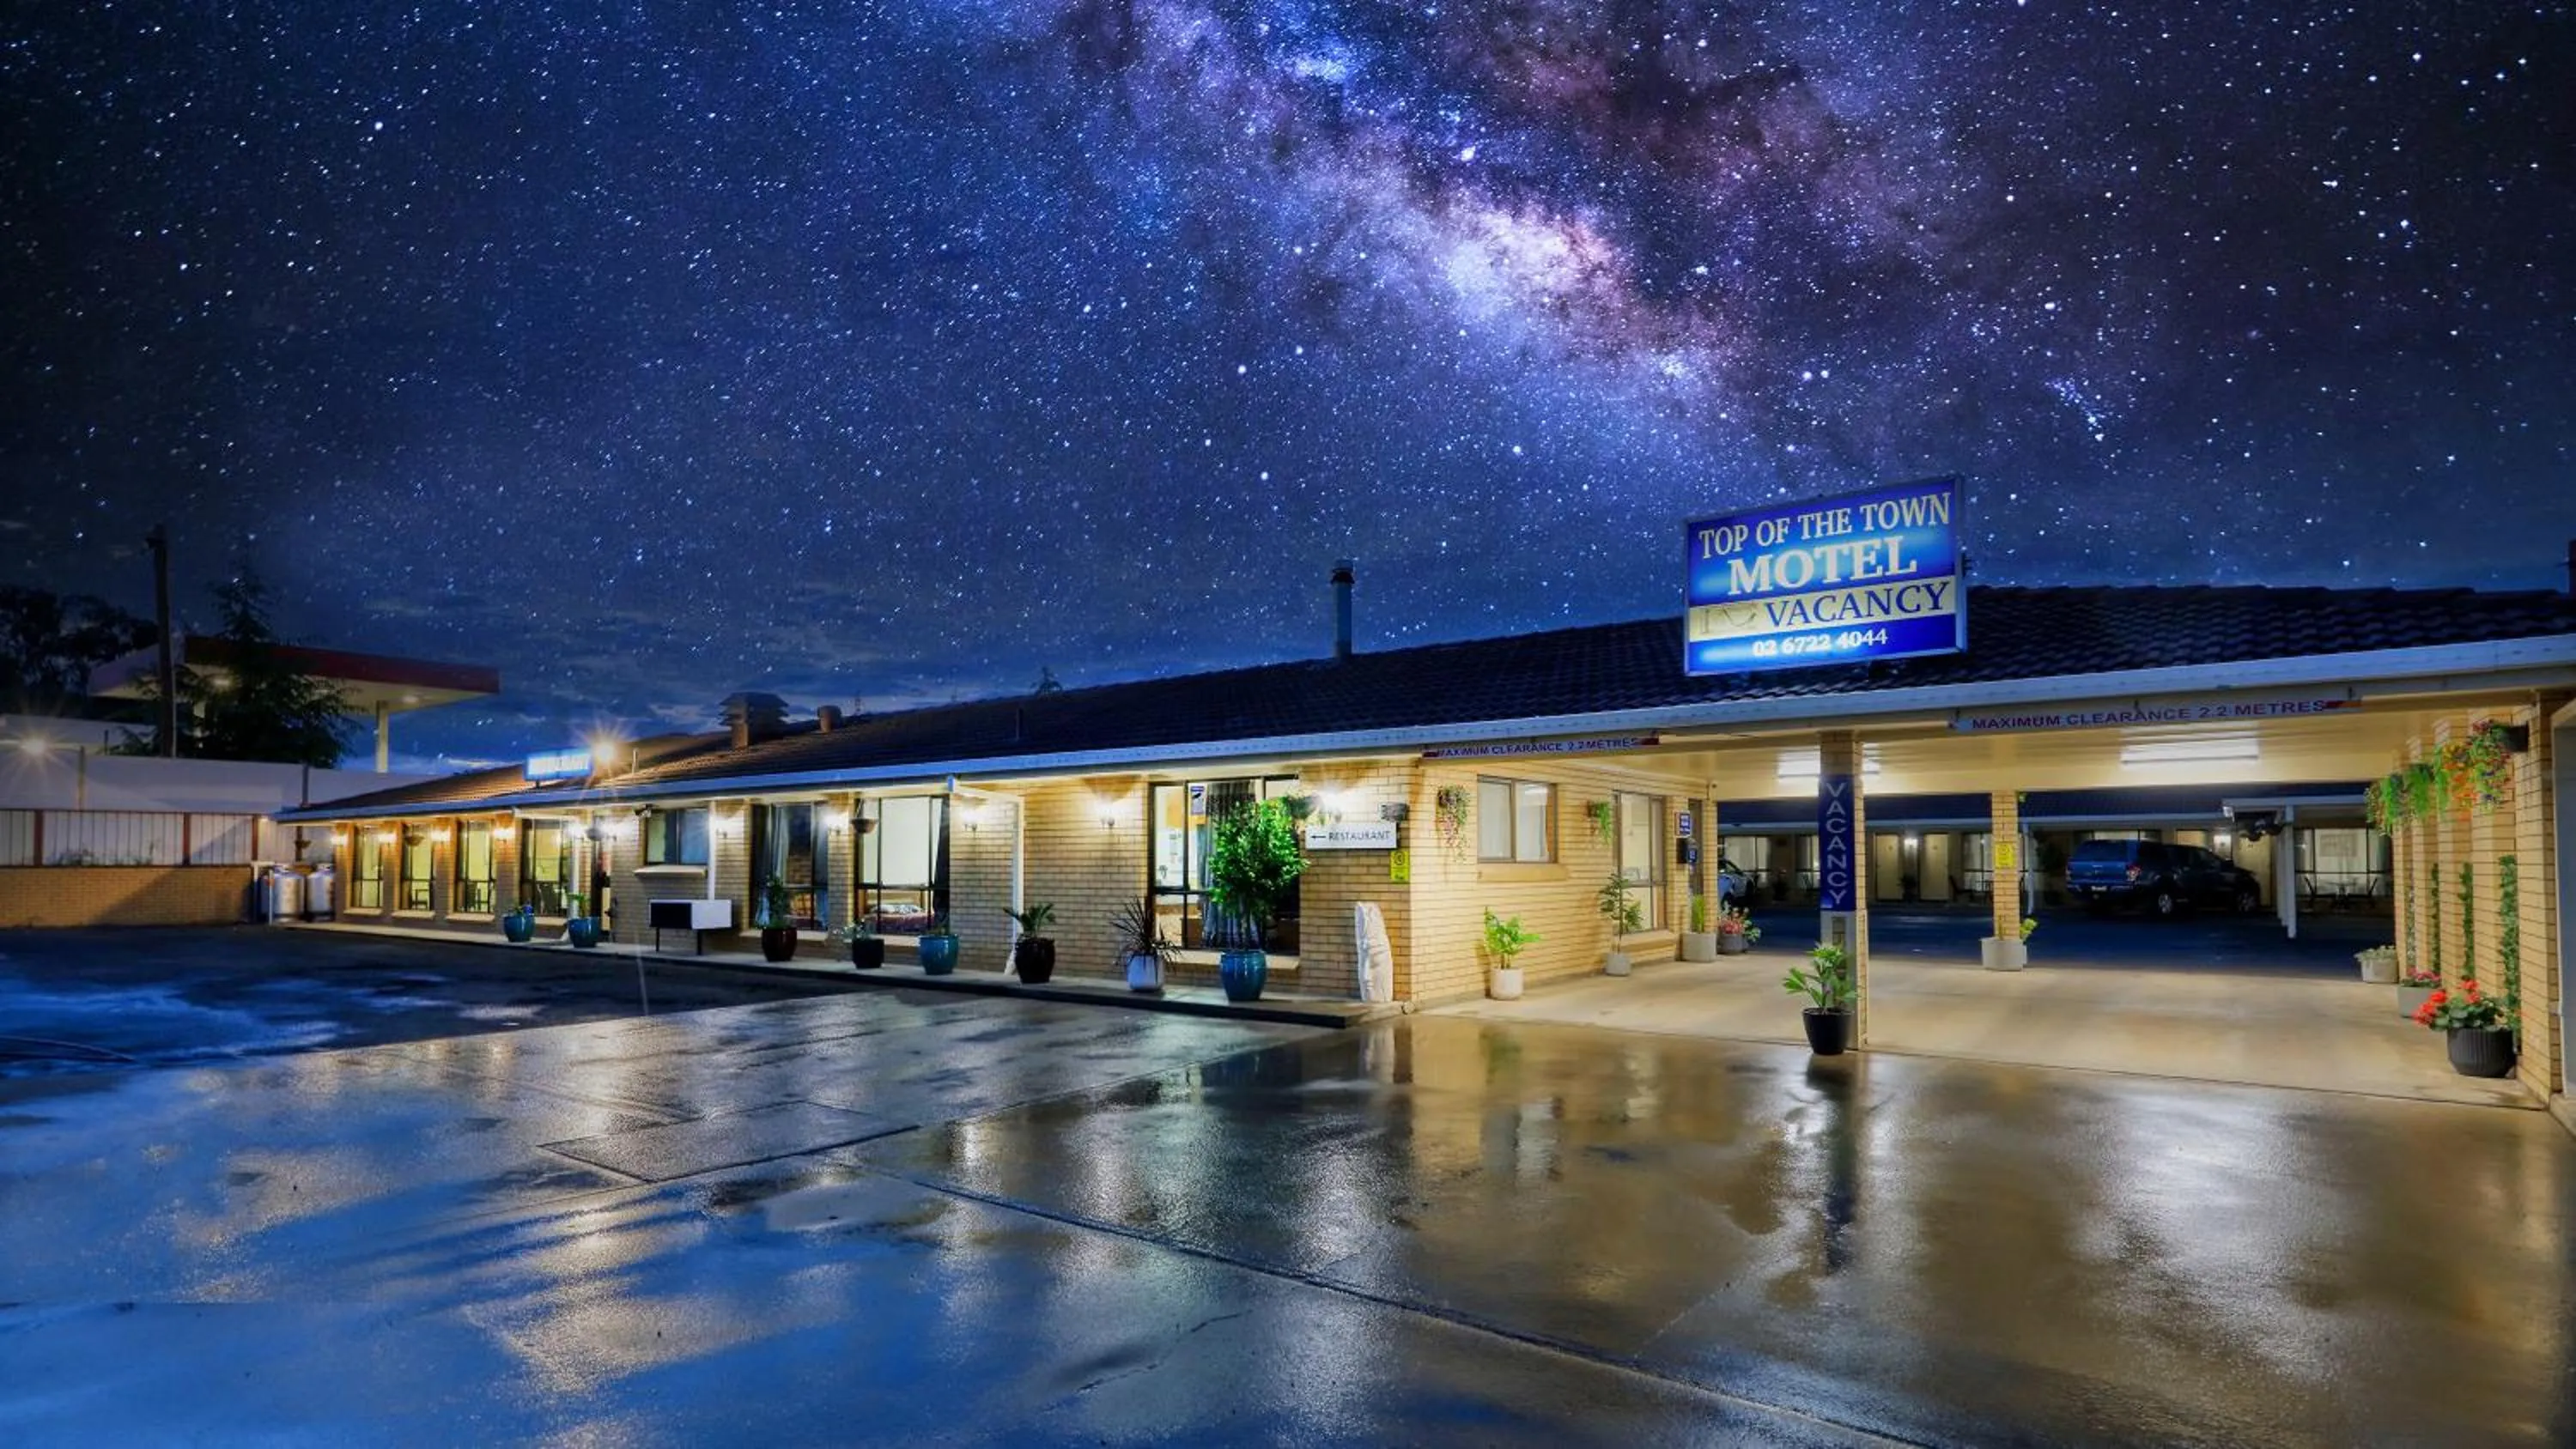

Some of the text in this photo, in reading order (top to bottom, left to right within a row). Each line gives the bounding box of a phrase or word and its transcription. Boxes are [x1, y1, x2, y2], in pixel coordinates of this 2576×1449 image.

[1698, 493, 1951, 558] TOP OF THE TOWN
[1728, 536, 1917, 596] MOTEL
[1765, 581, 1950, 627] VACANCY
[1753, 628, 1888, 657] 02 6722 4044
[1972, 700, 2324, 729] MAXIMUM CLEARANCE 2.2 METRES
[1492, 742, 1563, 755] CLEARANCE
[1568, 741, 1584, 751] 2.2
[1586, 737, 1638, 749] METRES
[1328, 831, 1390, 840] RESTAURANT
[1826, 782, 1848, 905] VACANCY
